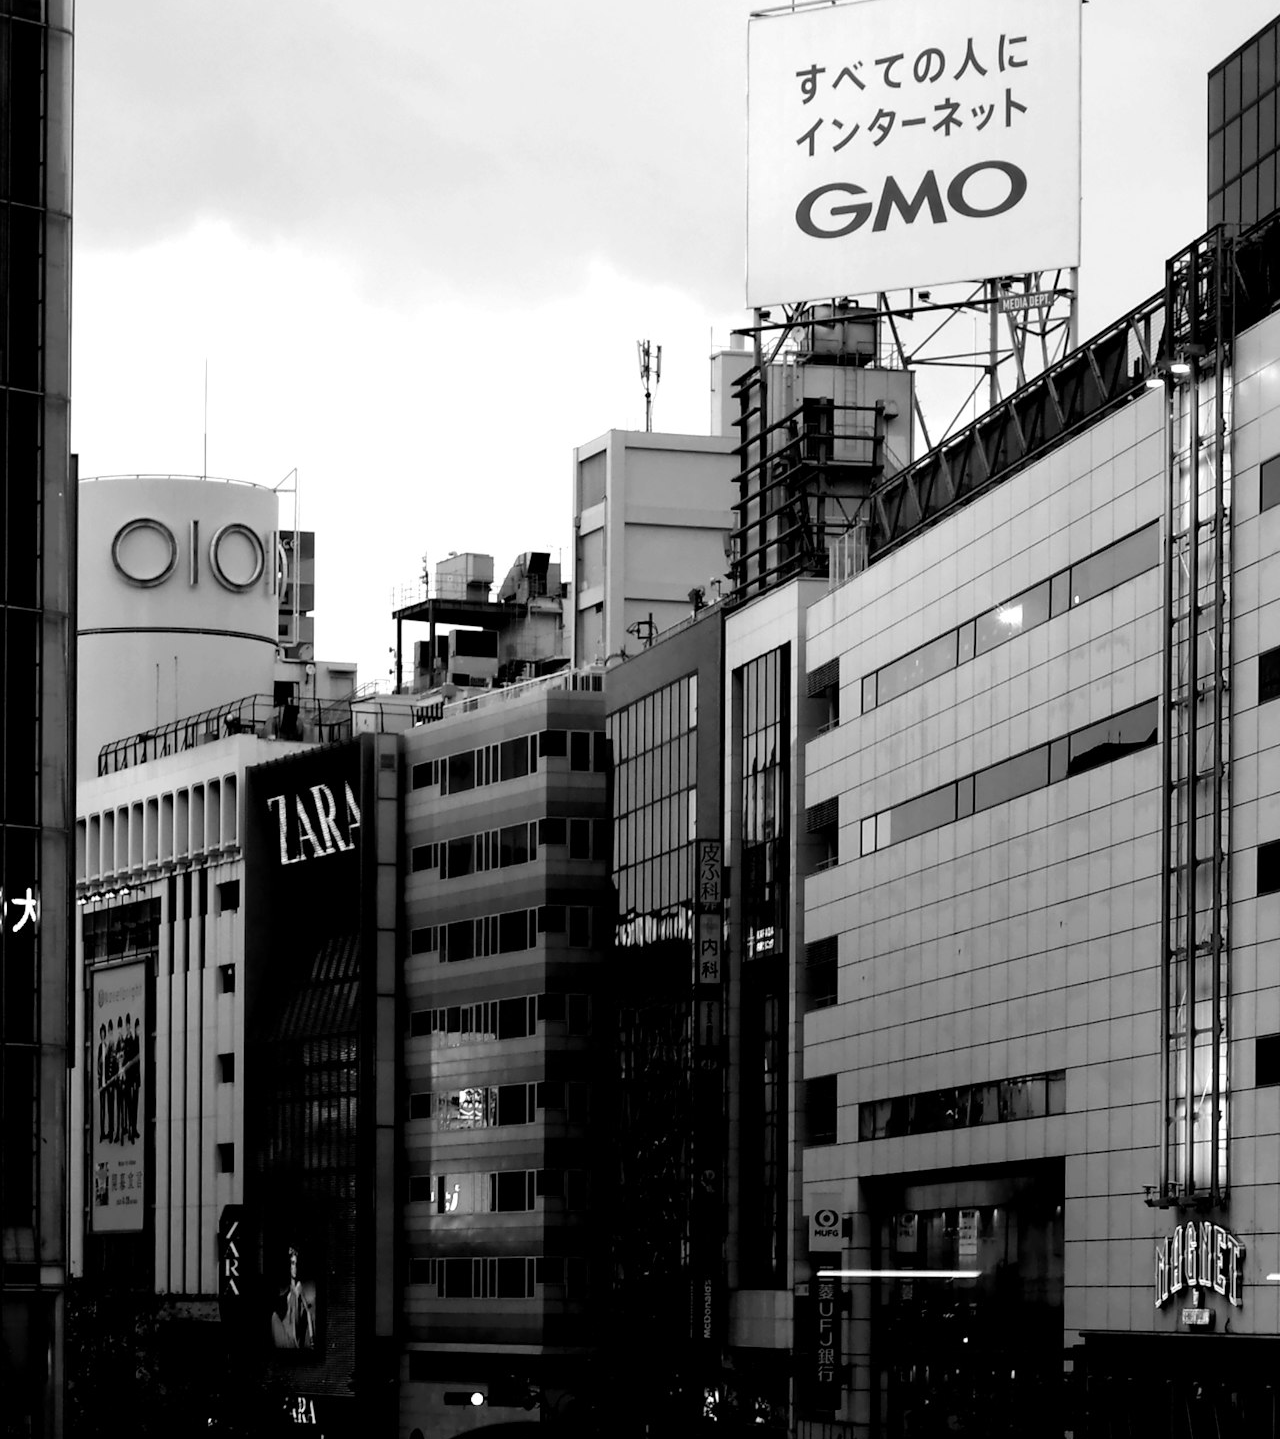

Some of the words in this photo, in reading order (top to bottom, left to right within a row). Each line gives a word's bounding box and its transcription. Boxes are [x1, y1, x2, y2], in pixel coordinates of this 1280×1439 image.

[795, 33, 1029, 106] すべての人に
[795, 87, 1028, 157] インターネット
[795, 160, 1028, 239] GMO
[1002, 296, 1029, 311] MEDIA
[1029, 293, 1051, 308] DEPT.
[266, 779, 362, 866] ZARA
[701, 843, 720, 901] 皮ふ科
[701, 938, 719, 979] 内科
[814, 1229, 840, 1238] MUFG
[1155, 1221, 1246, 1309] MAGNET
